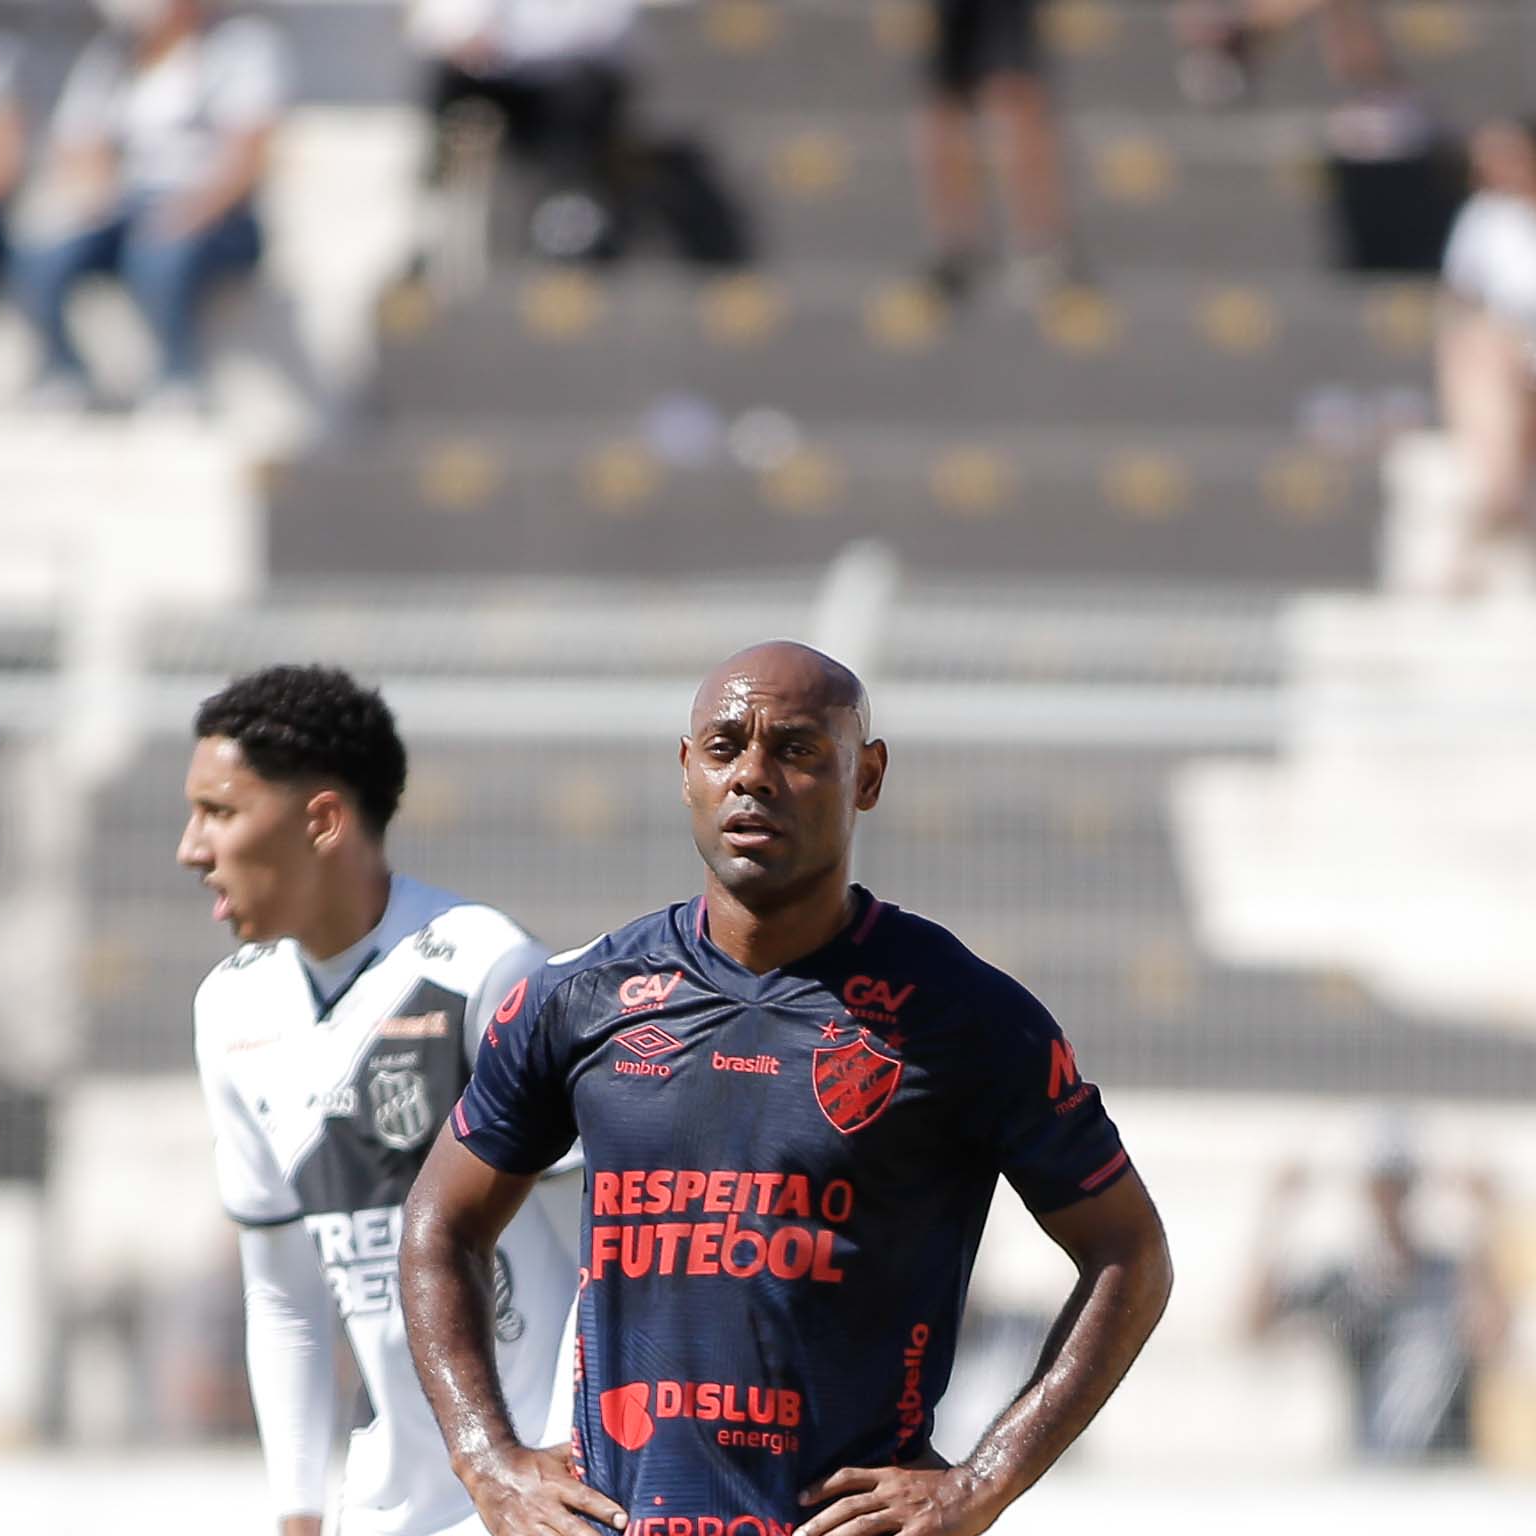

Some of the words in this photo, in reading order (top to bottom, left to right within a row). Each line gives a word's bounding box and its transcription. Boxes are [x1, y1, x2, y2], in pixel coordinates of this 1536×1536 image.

[615, 1060, 672, 1077] umbro
[712, 1051, 781, 1075] brasilit
[593, 1170, 810, 1216] RESPEITA
[821, 1179, 854, 1223] O
[656, 1380, 801, 1427] DISLUB
[718, 1429, 799, 1455] energia
